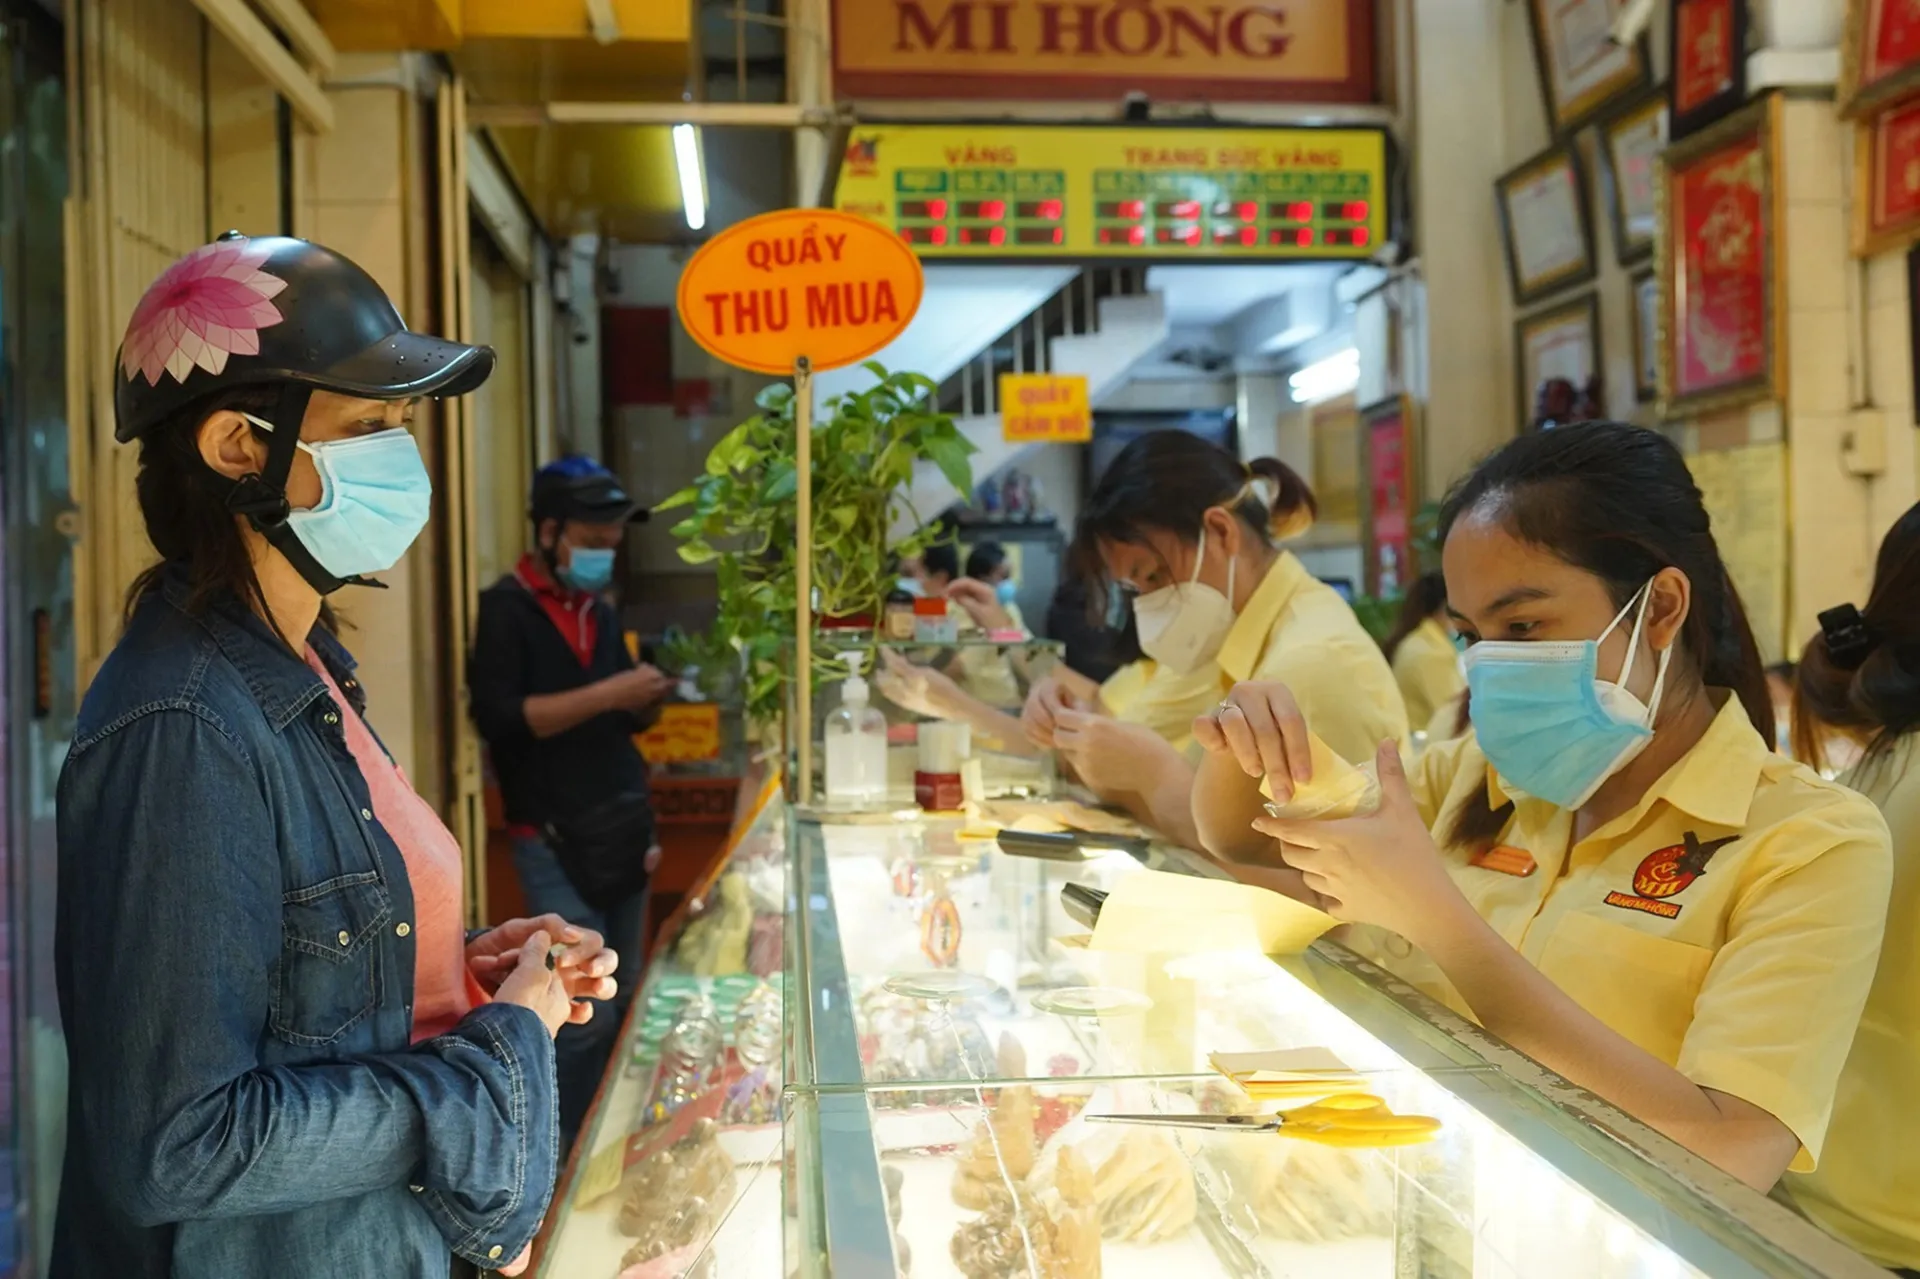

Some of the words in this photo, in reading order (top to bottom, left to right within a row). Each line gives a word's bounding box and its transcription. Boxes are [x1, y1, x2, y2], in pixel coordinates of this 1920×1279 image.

[892, 1, 1017, 54] MI
[704, 288, 790, 336] THU
[806, 280, 900, 330] MUA
